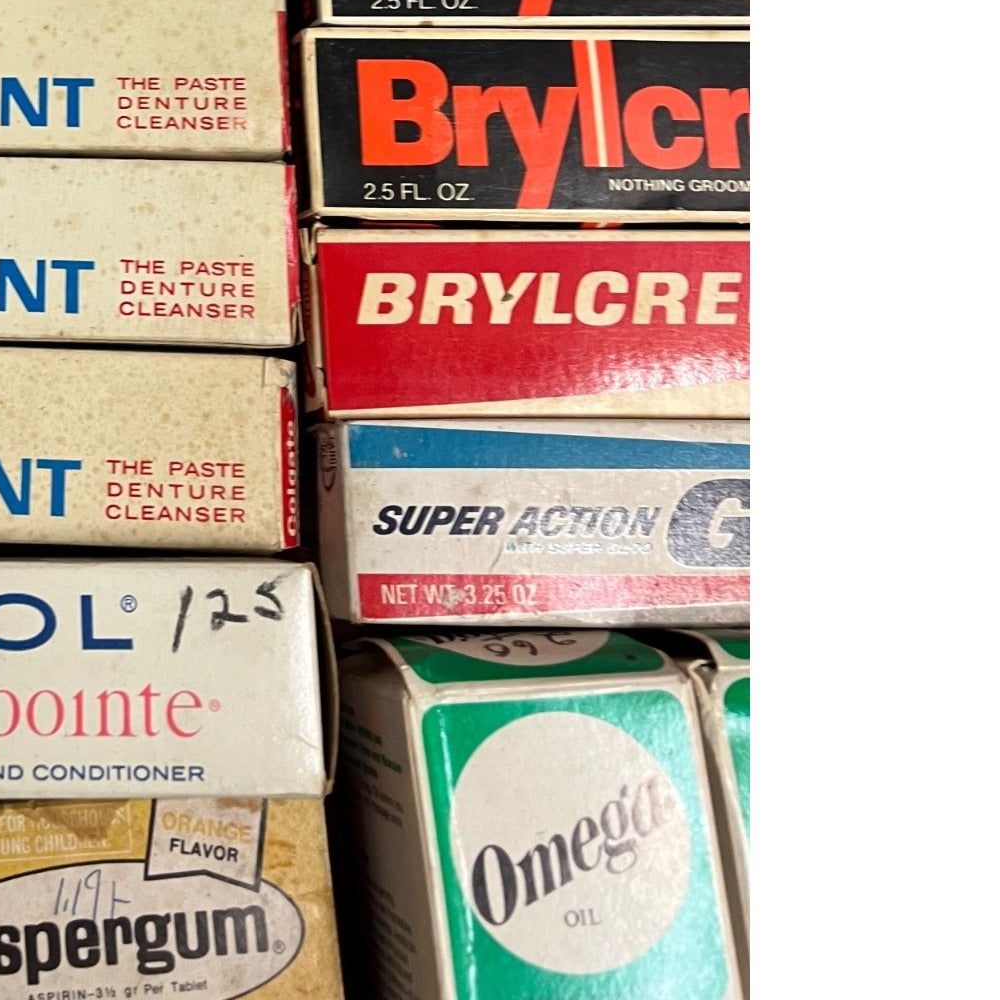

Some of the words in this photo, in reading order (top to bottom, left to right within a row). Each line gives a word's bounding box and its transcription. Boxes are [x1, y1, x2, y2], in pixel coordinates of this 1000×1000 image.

[116, 76, 160, 91] THE
[175, 77, 247, 91] PASTE
[118, 96, 247, 111] DENTURE
[116, 115, 247, 131] CLEANSER
[609, 178, 685, 193] NOTHING
[119, 259, 165, 275] THE
[181, 261, 254, 277] PASTE
[120, 280, 255, 298] DENTURE
[119, 301, 255, 320] CLEANSER
[106, 459, 153, 476] THE
[169, 461, 245, 478] PASTE
[107, 482, 246, 501] DENTURE
[106, 504, 246, 523] CLEANSER
[373, 505, 504, 536] SUPER
[509, 506, 661, 537] ACTION
[380, 584, 417, 605] NET
[32, 764, 205, 782] CONDITIONER
[161, 811, 252, 843] ORANGE
[169, 838, 239, 862] FLAVOR
[472, 775, 671, 926] Omega
[563, 907, 601, 928] OIL
